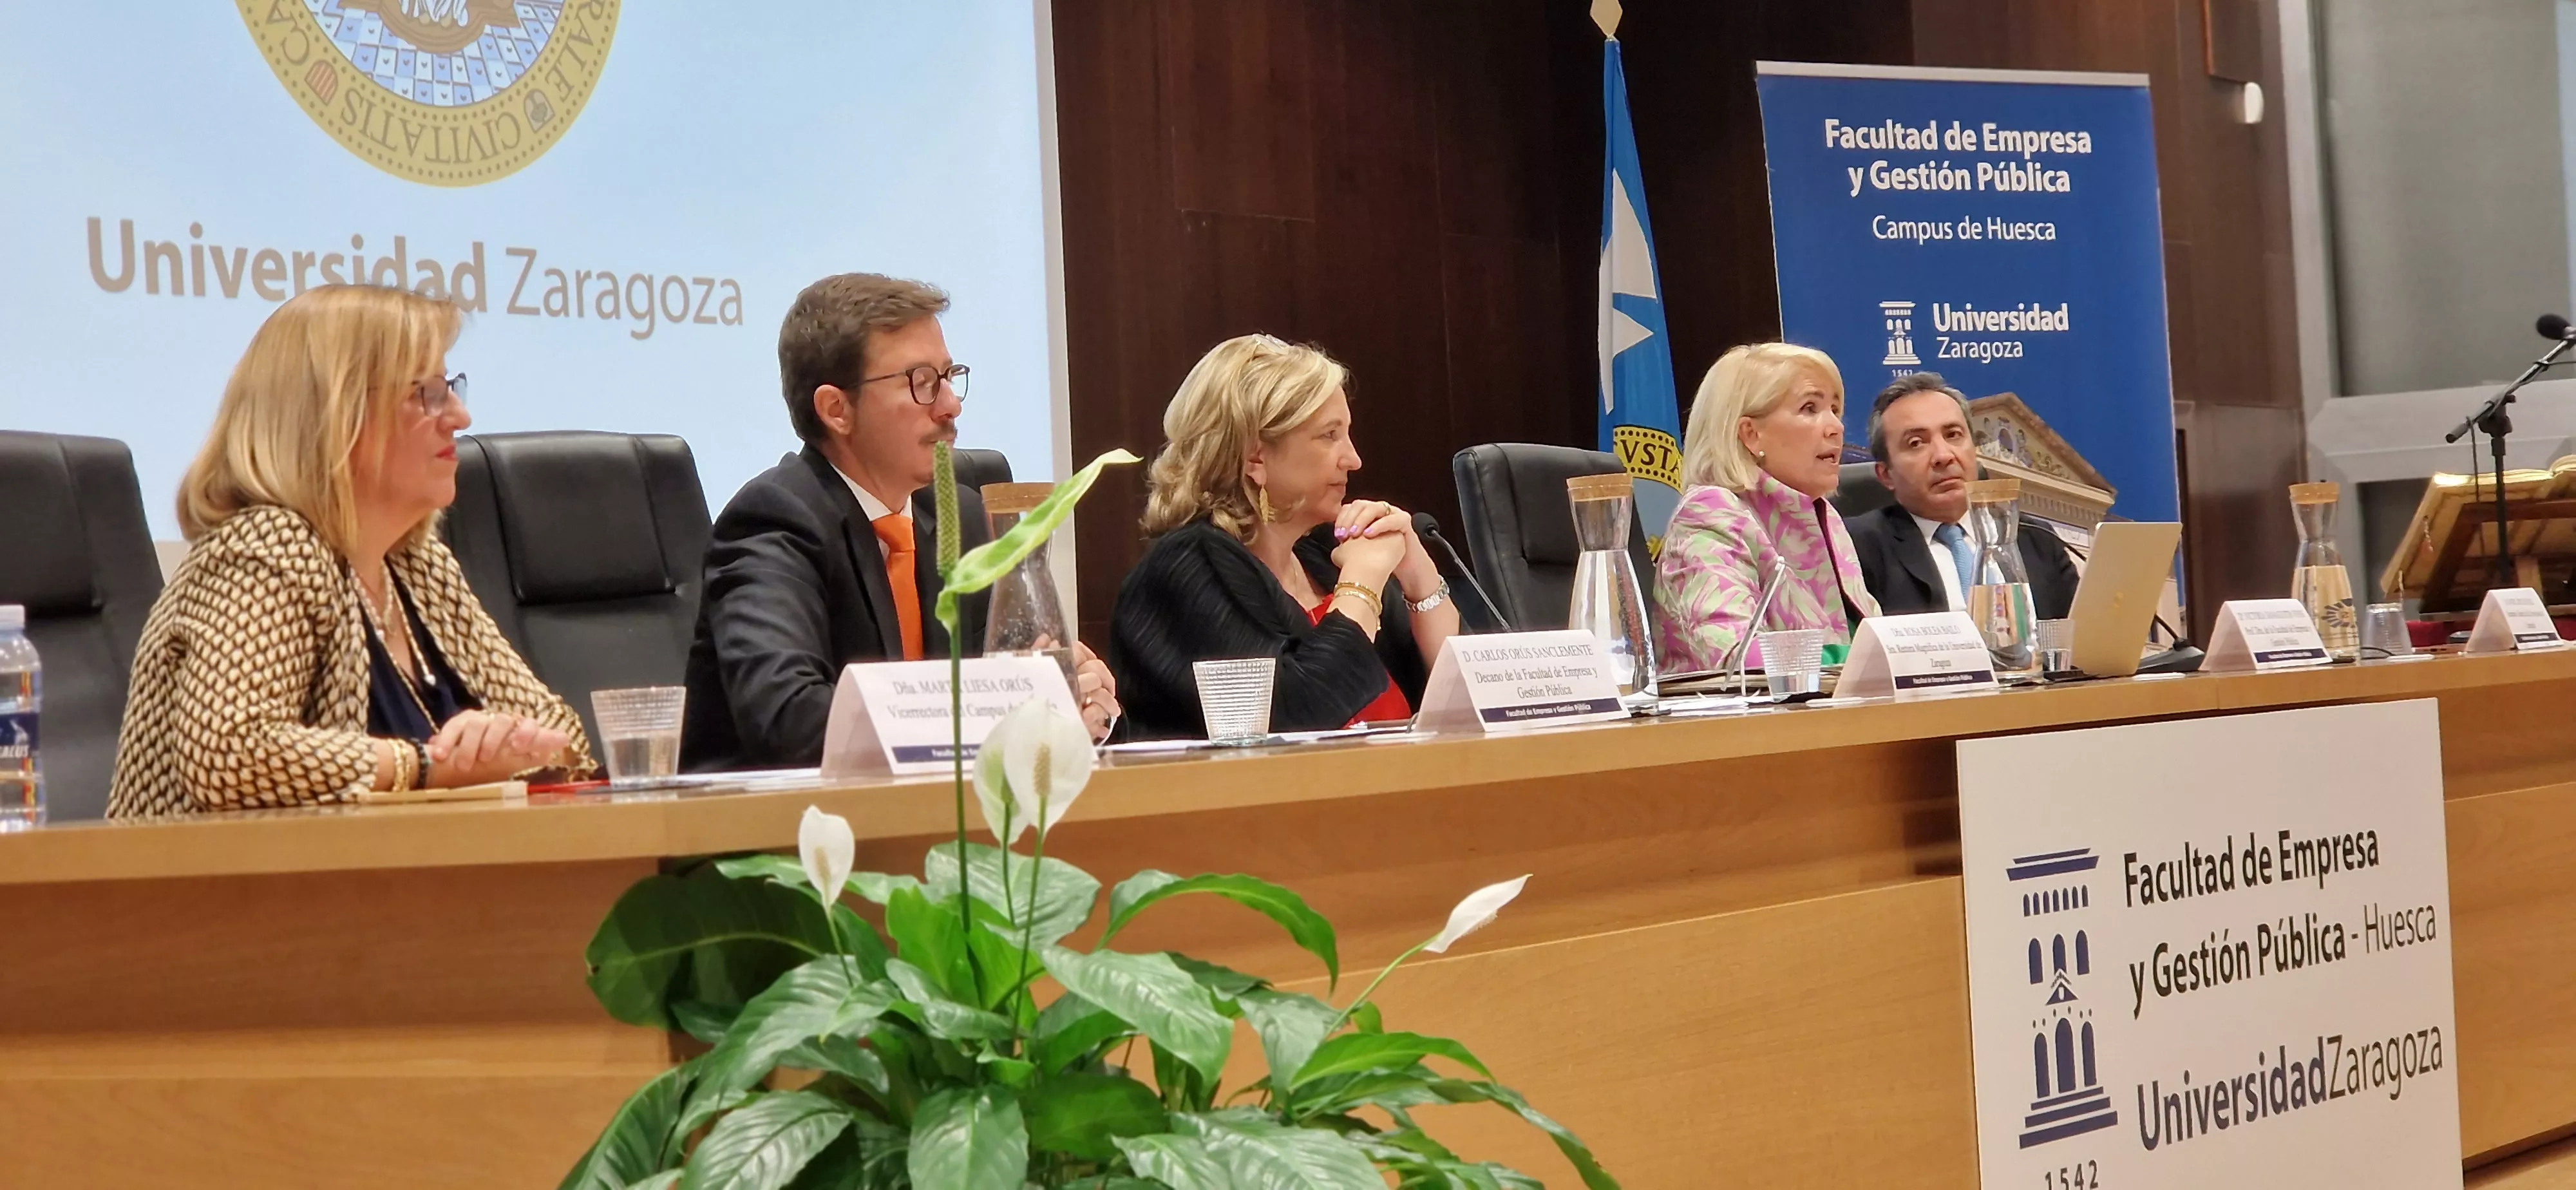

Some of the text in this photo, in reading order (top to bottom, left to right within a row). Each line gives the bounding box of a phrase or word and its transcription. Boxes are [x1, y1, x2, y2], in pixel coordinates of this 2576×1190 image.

[339, 87, 521, 164] CIVITATIS
[1824, 118, 2092, 159] Facultad de Empresa
[1847, 160, 2071, 198] y Gestión Pública
[1872, 214, 2056, 245] Campus de Huesca
[504, 246, 743, 341] Zaragoza
[1933, 303, 2069, 332] Universidad
[1936, 336, 2023, 364] Zaragoza
[1473, 648, 1509, 662] CARLOS
[1508, 645, 1533, 659] ORÚS
[1532, 645, 1593, 658] SANCLEMENTE
[918, 679, 963, 694] MART
[999, 674, 1034, 692] ORÚS
[1475, 665, 1598, 683] Decano de la Facultad de Empresa y
[1517, 684, 1573, 699] Gestión Pública
[2124, 829, 2380, 908] Facultad de Empresa
[2129, 961, 2145, 1020] y
[2152, 928, 2251, 997] Gestión
[2257, 912, 2346, 976] Pública
[2363, 902, 2437, 954] Huesca
[2045, 1159, 2099, 1190] 1542
